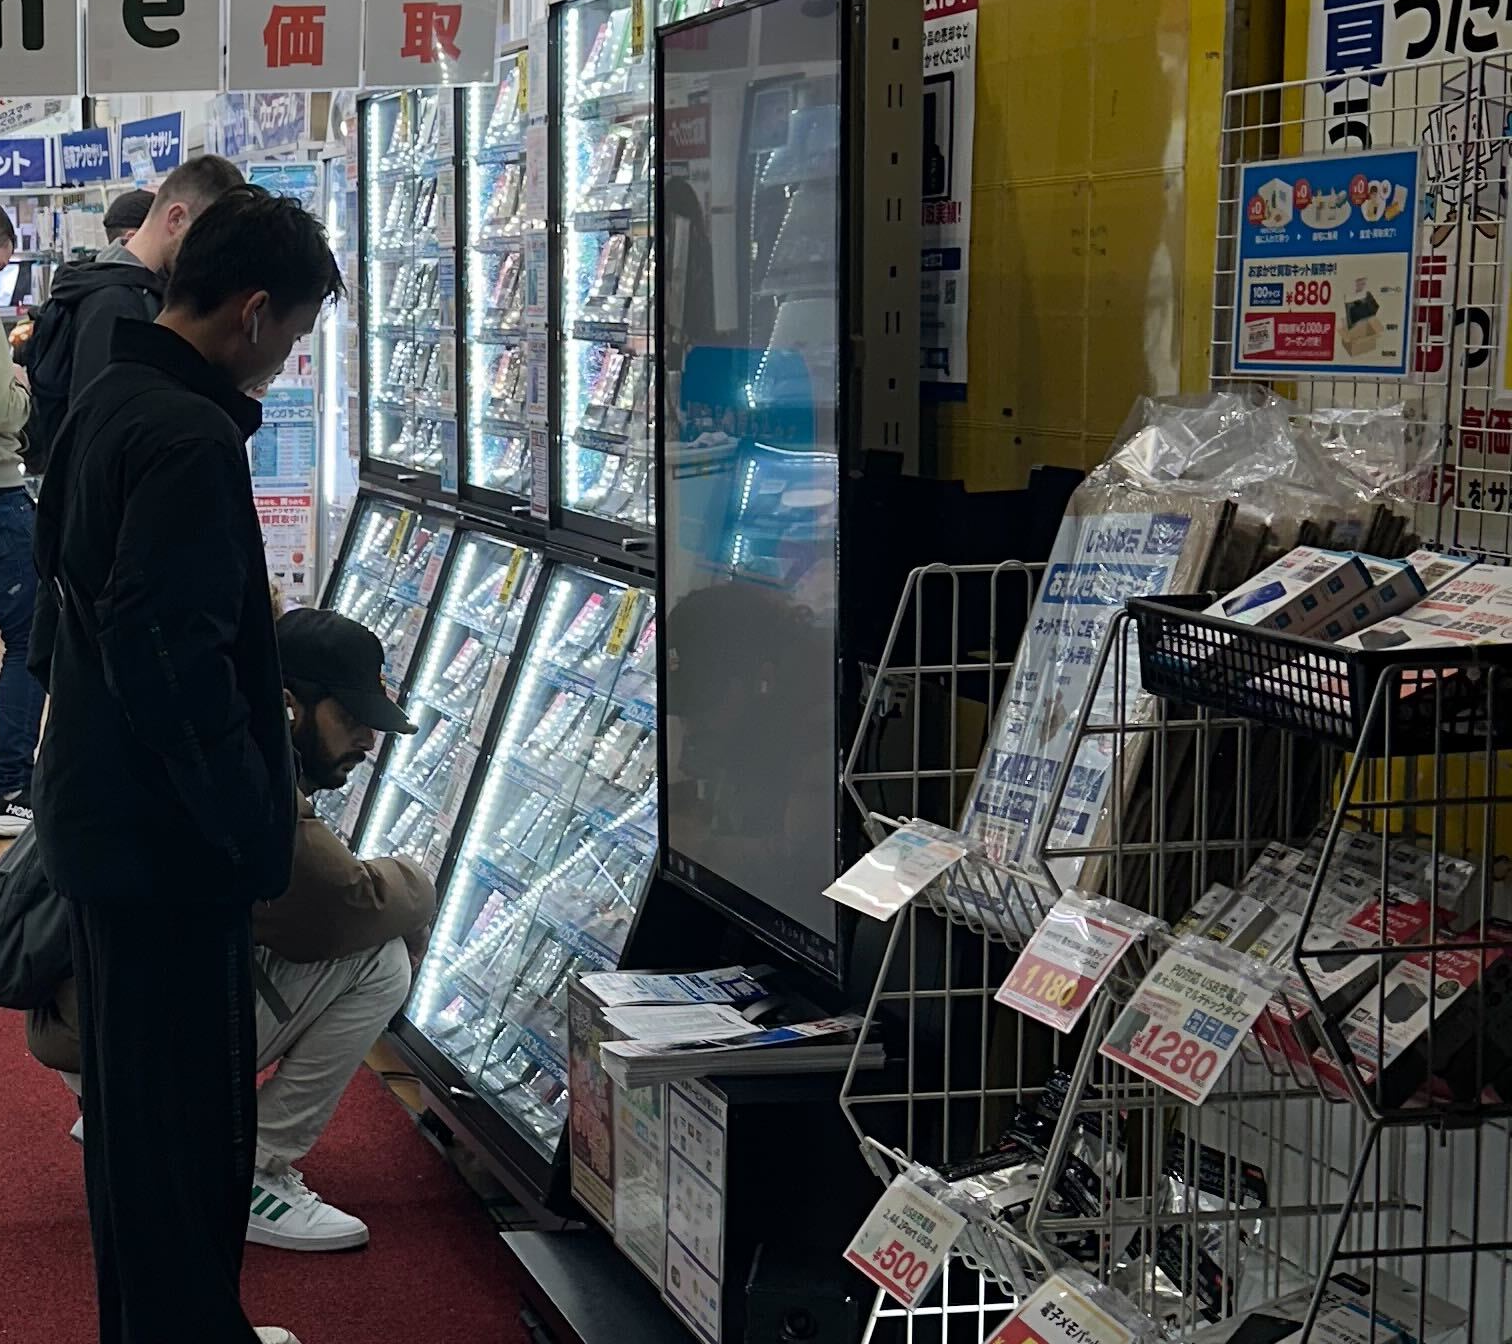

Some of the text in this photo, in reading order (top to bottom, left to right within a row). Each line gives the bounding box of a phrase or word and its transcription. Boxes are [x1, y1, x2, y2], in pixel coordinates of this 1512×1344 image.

[1286, 280, 1331, 306] ¥880
[1132, 1021, 1217, 1084] ¥1,280
[872, 1237, 929, 1289] ¥500
